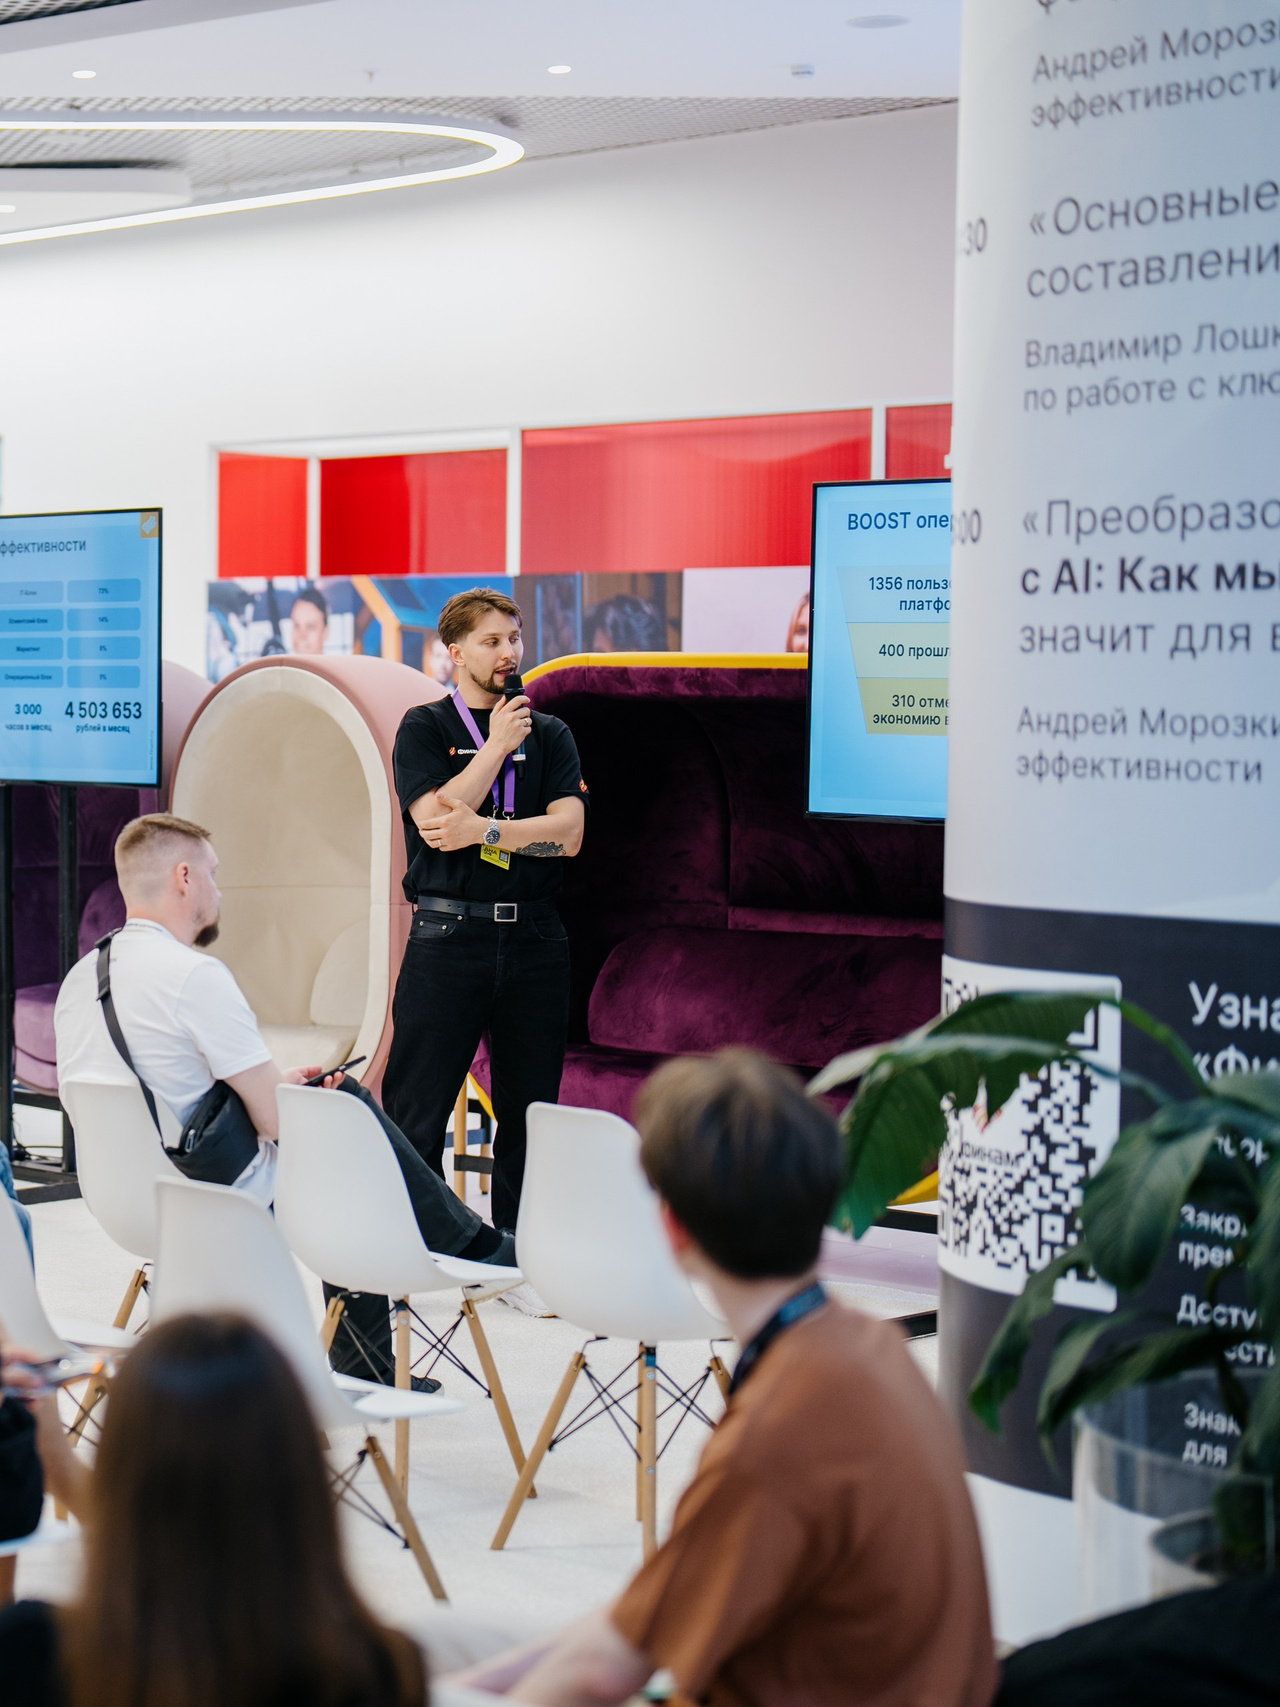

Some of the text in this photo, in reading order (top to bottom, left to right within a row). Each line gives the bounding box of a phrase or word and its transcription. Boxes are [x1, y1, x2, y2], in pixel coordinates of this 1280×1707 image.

[1032, 19, 1280, 83] Андрей Мороз
[1029, 180, 1280, 236] «Основные
[1025, 331, 1182, 369] Владимир
[1023, 387, 1057, 412] по
[1067, 376, 1177, 414] работе
[1187, 376, 1206, 400] с
[848, 512, 952, 533] BOOST опе
[869, 576, 952, 591] 1356 польз
[1021, 568, 1040, 595] с
[1053, 557, 1103, 595] AI:
[1118, 556, 1199, 593] Как
[879, 644, 904, 657] 400
[1019, 622, 1154, 653] значит
[1169, 622, 1251, 660] для
[15, 704, 42, 715] 3 000
[65, 702, 142, 719] 4 503 653
[892, 695, 915, 708] 310
[31, 724, 52, 732] месяц
[76, 724, 101, 733] рублей
[108, 725, 130, 733] месяц
[872, 713, 941, 726] экономию
[1016, 706, 1128, 740] Андрей
[1016, 750, 1263, 784] эффективности
